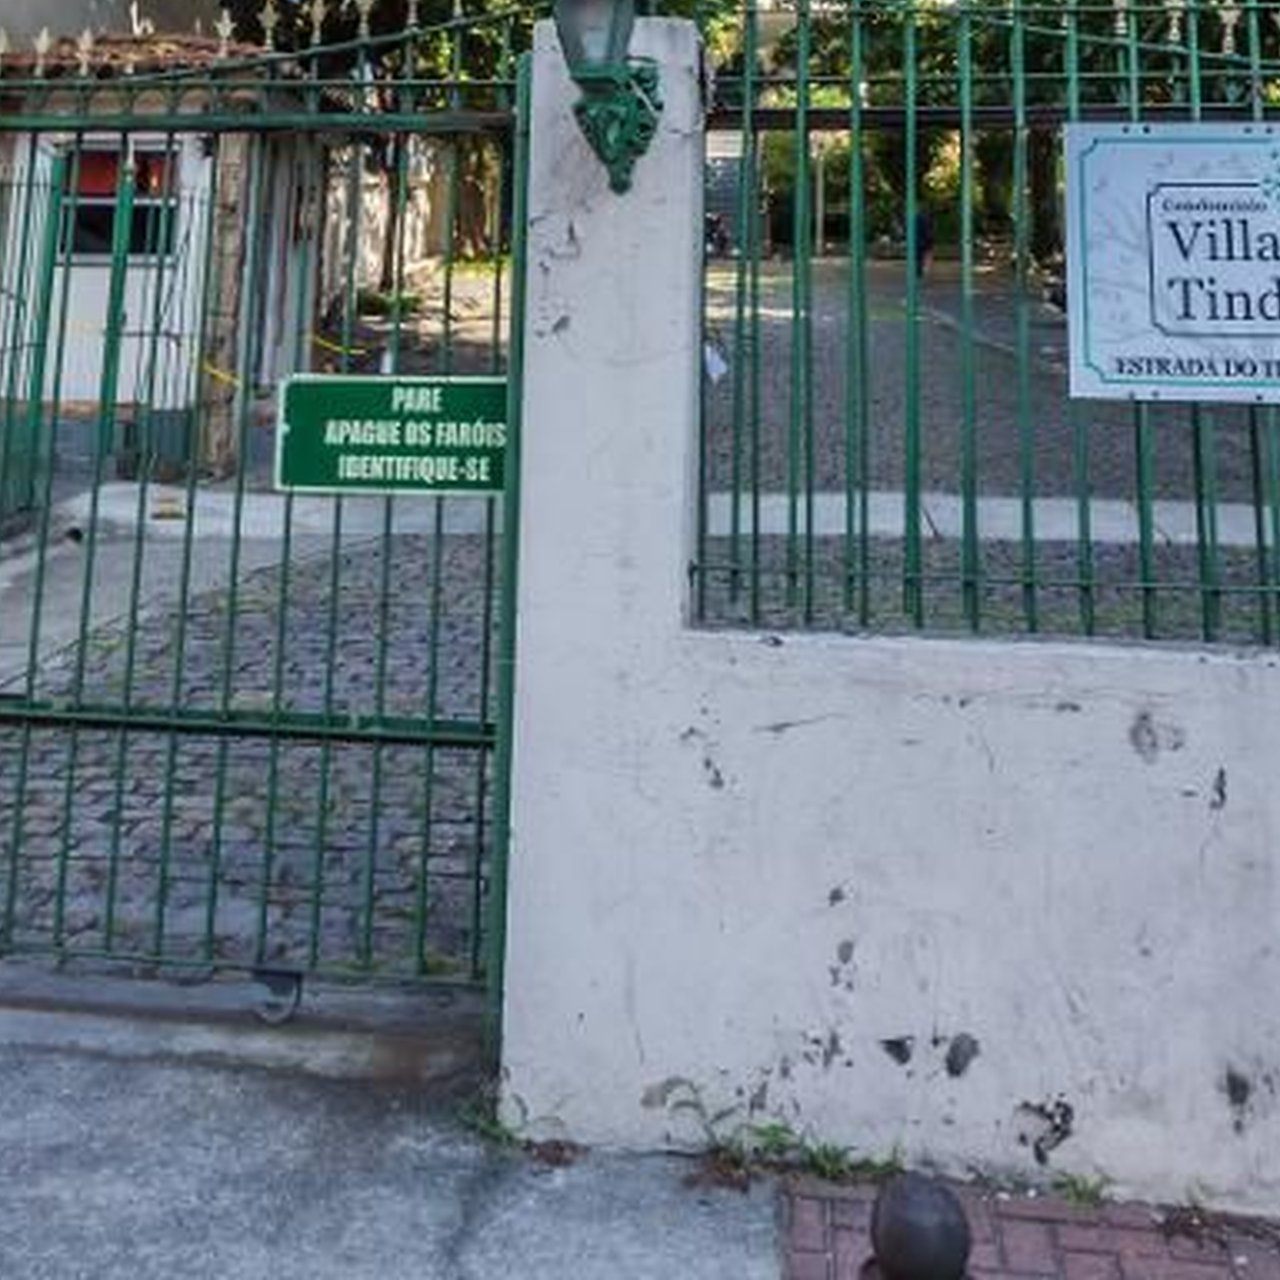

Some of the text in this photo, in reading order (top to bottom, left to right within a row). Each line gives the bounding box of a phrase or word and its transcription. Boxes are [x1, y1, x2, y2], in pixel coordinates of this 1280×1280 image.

[1116, 356, 1218, 378] ESTRADA
[1223, 357, 1258, 378] DO
[391, 385, 444, 413] PARE
[323, 416, 508, 448] APAGUE OS FARÓIS
[338, 454, 490, 483] IDENTIFIQUE-SE
